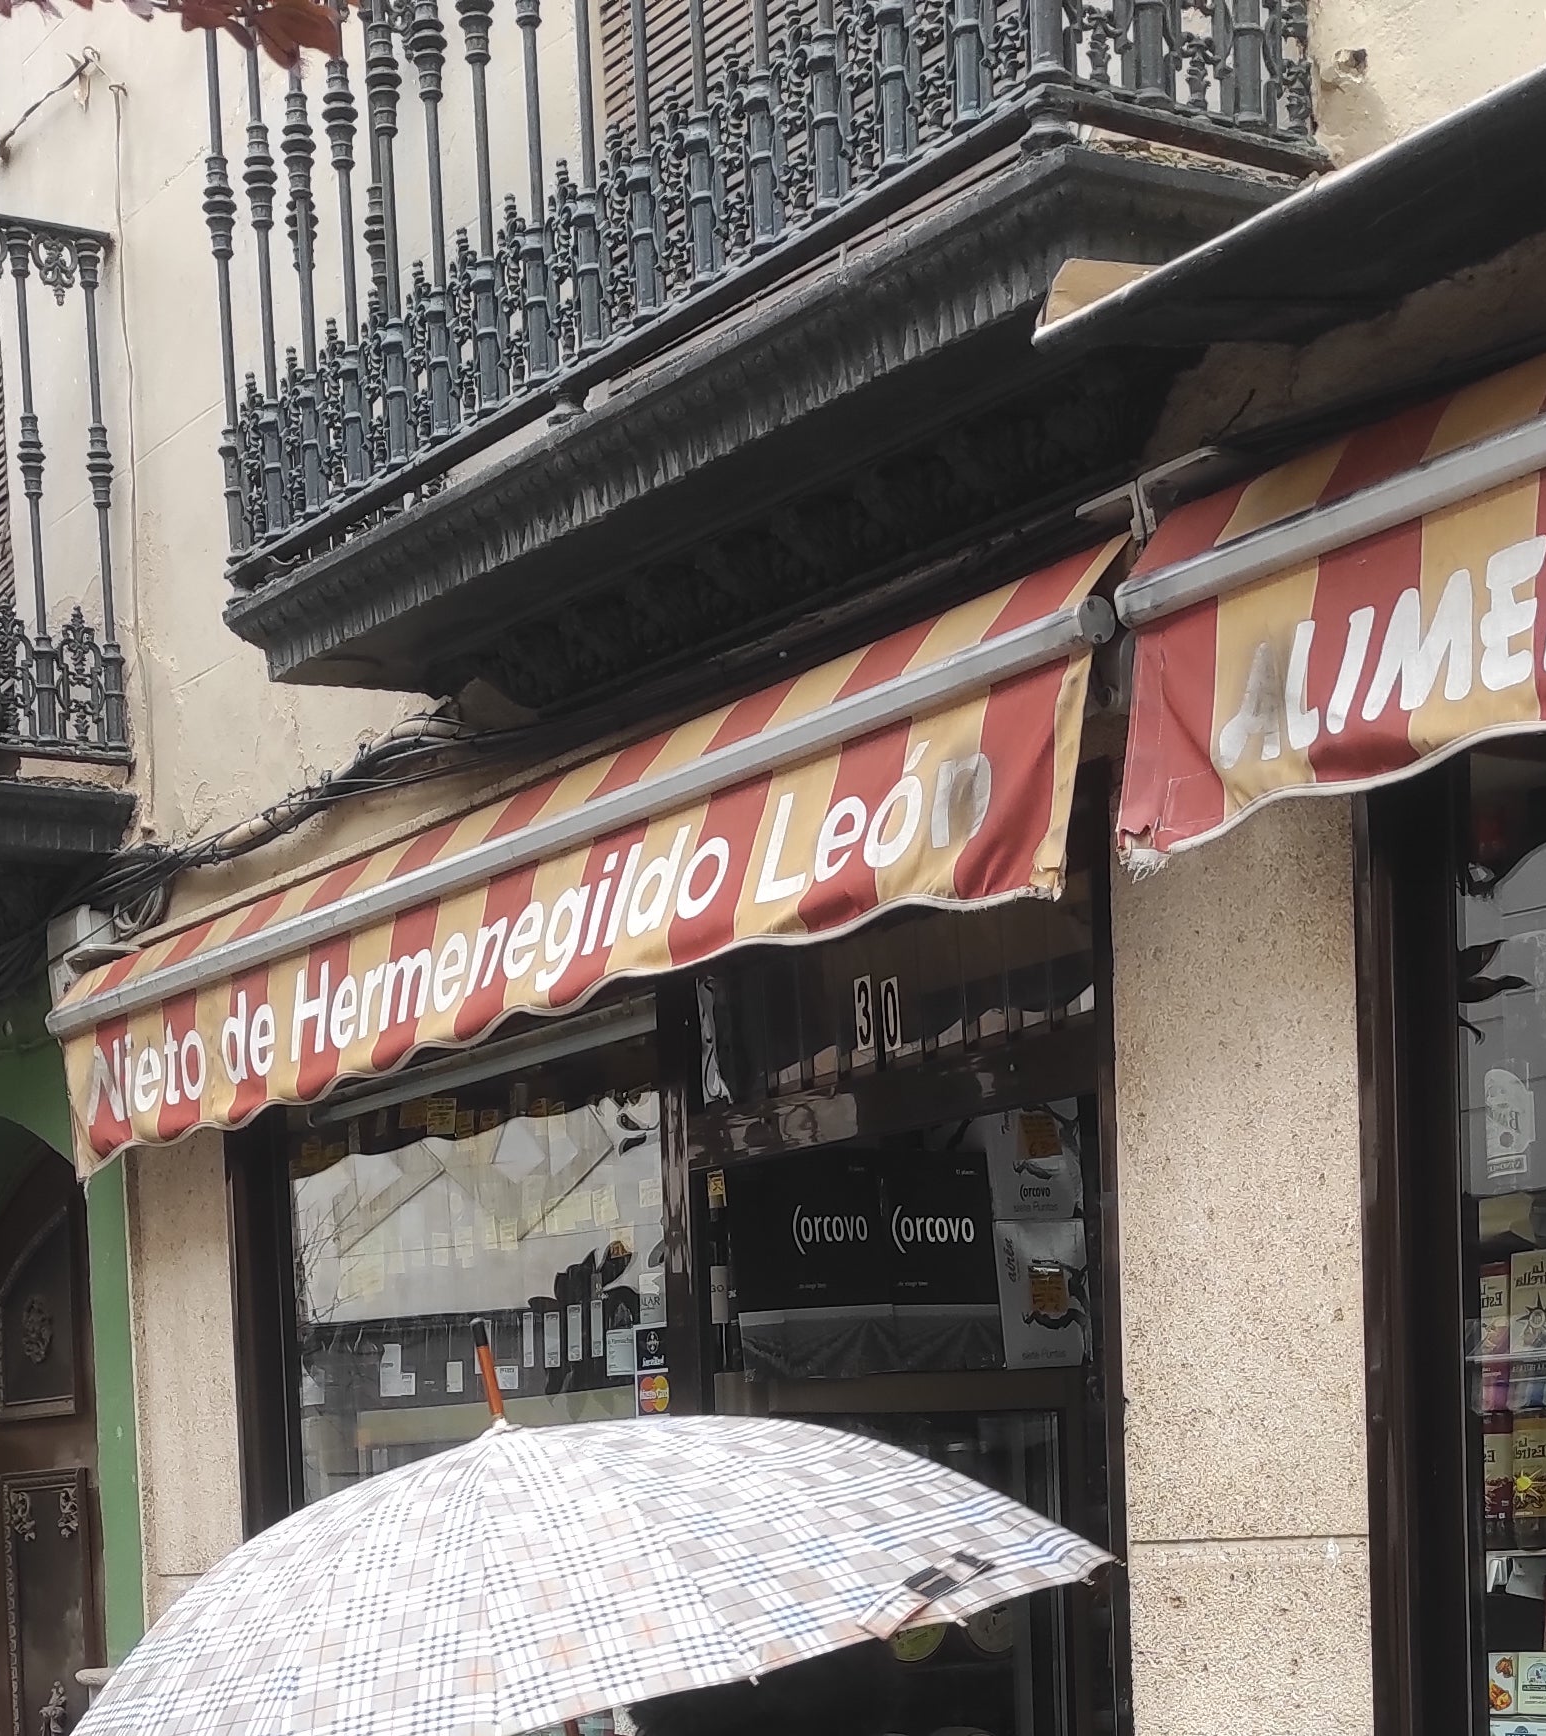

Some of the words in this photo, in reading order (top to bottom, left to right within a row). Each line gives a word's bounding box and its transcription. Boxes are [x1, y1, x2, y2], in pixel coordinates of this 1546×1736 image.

[87, 1026, 207, 1125] Nieto
[219, 990, 276, 1078] de
[289, 824, 730, 1061] Hermenegildo
[753, 738, 993, 905] León
[853, 975, 901, 1052] 30
